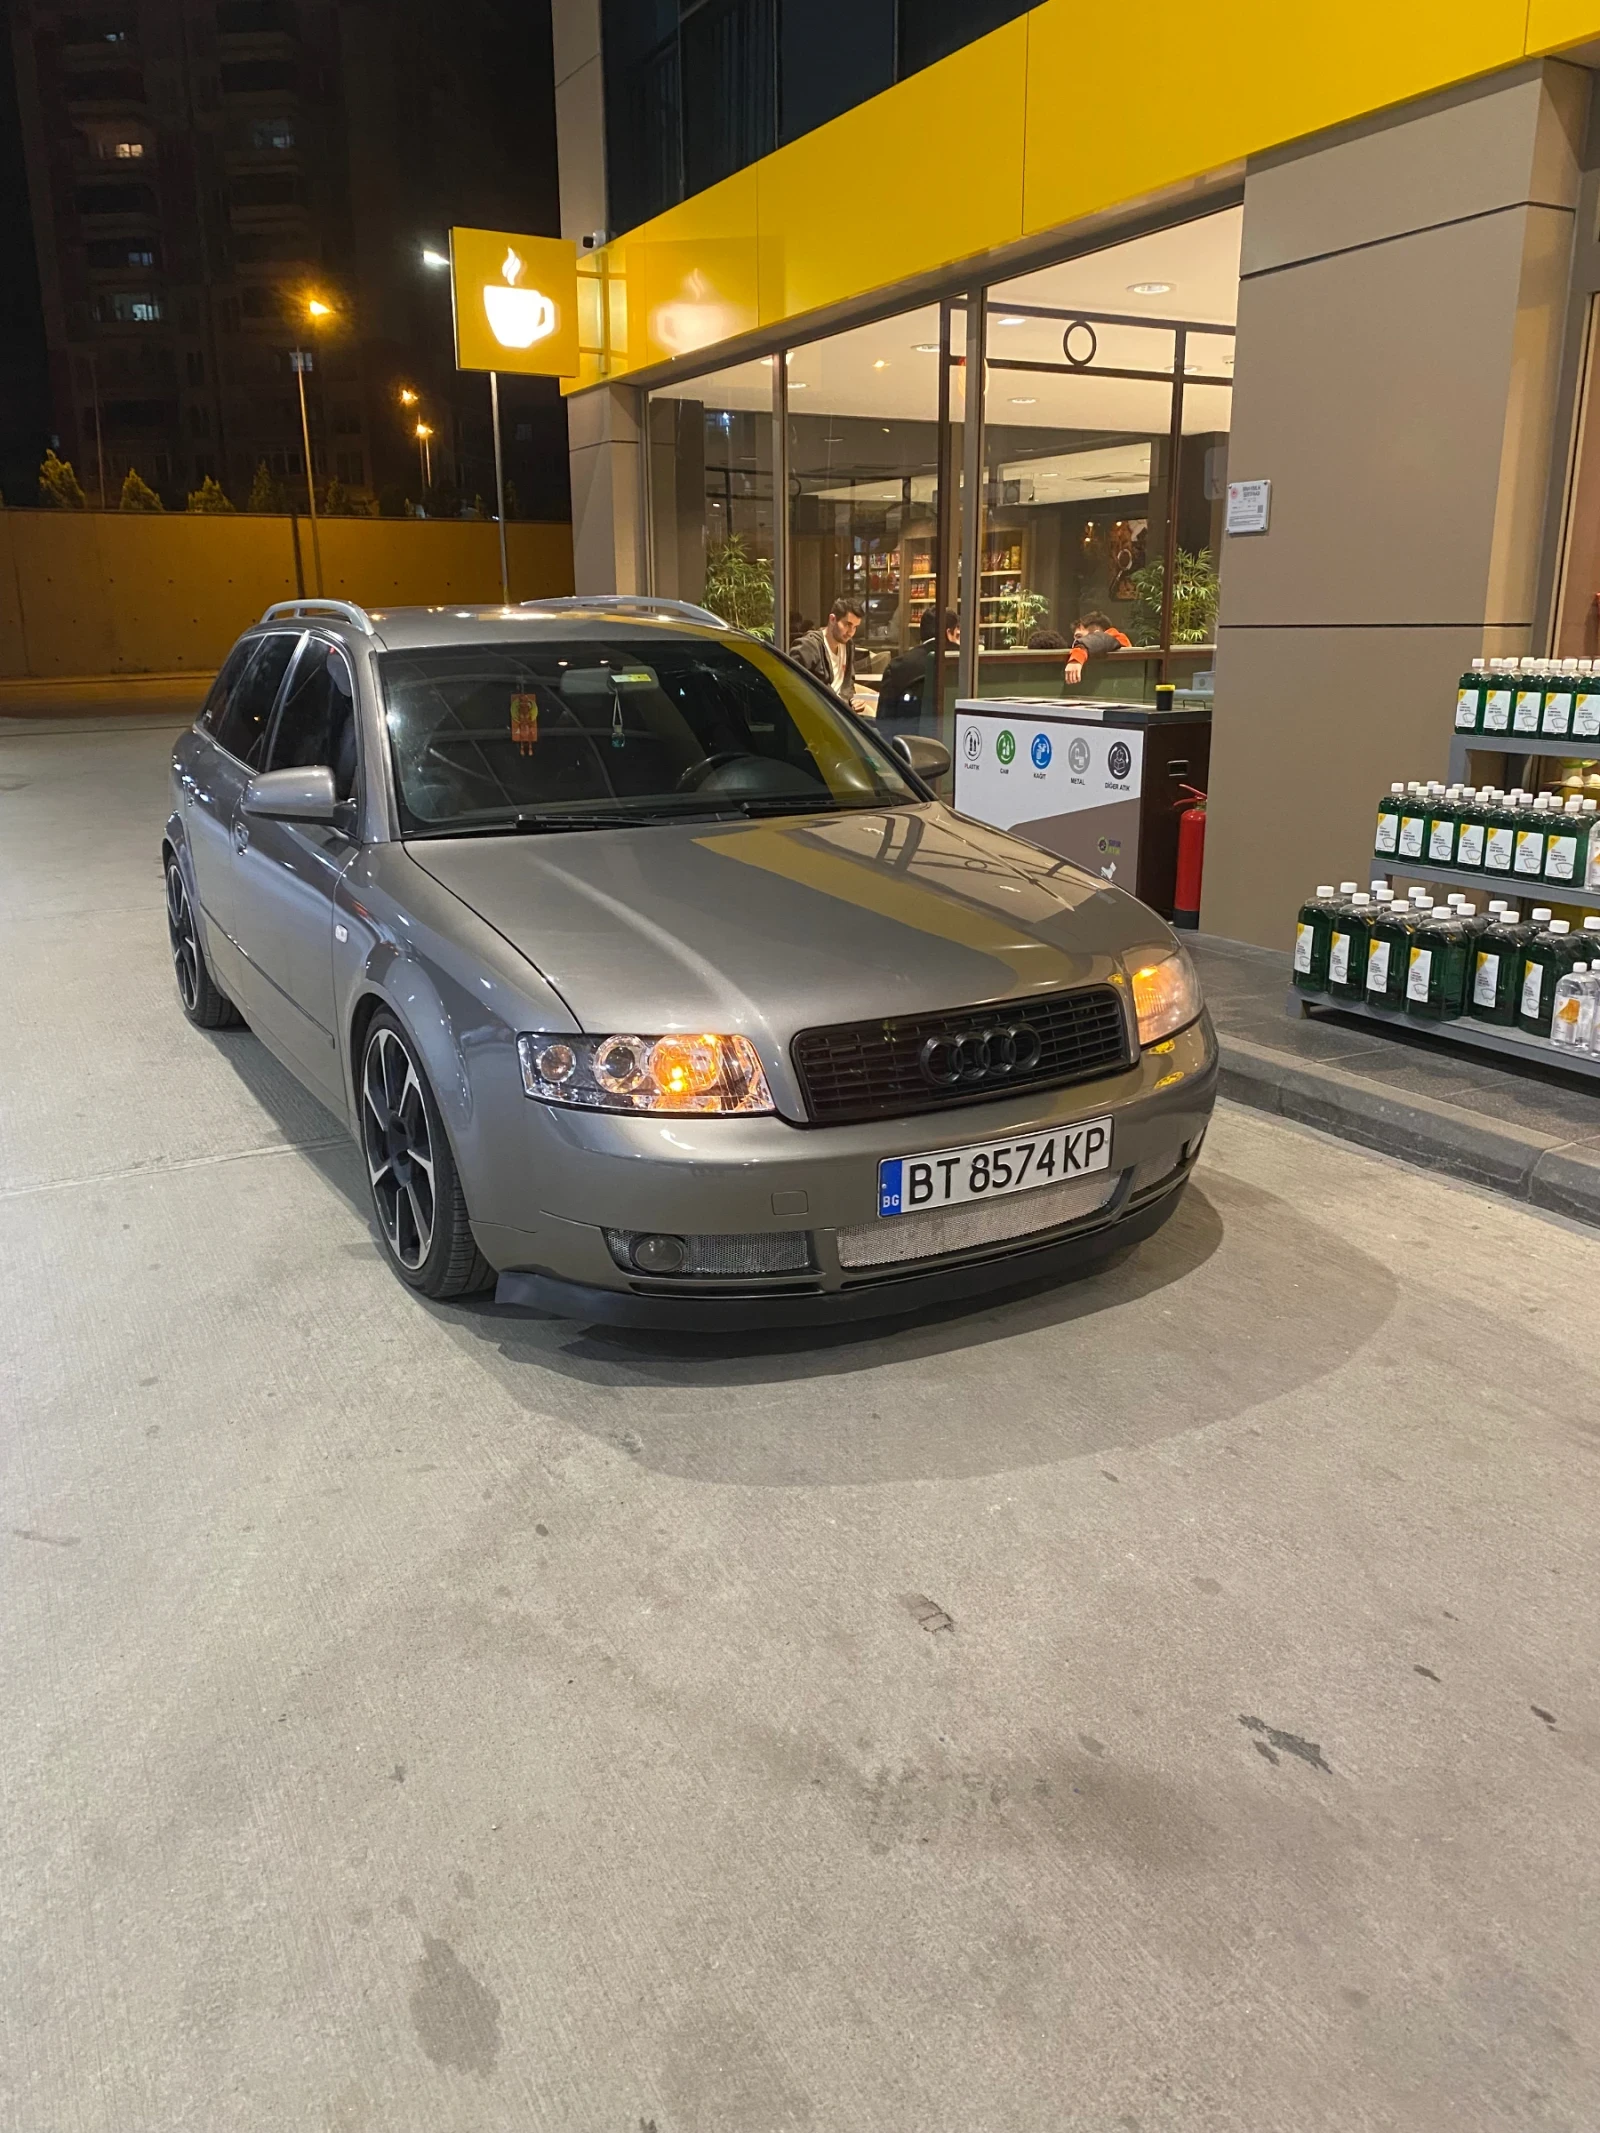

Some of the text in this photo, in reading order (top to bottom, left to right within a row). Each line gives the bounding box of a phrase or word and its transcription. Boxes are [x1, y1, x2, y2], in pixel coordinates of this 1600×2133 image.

[1070, 777, 1085, 785] METAL
[908, 1127, 1105, 1205] BT 8574 KP
[882, 1194, 900, 1208] BG
